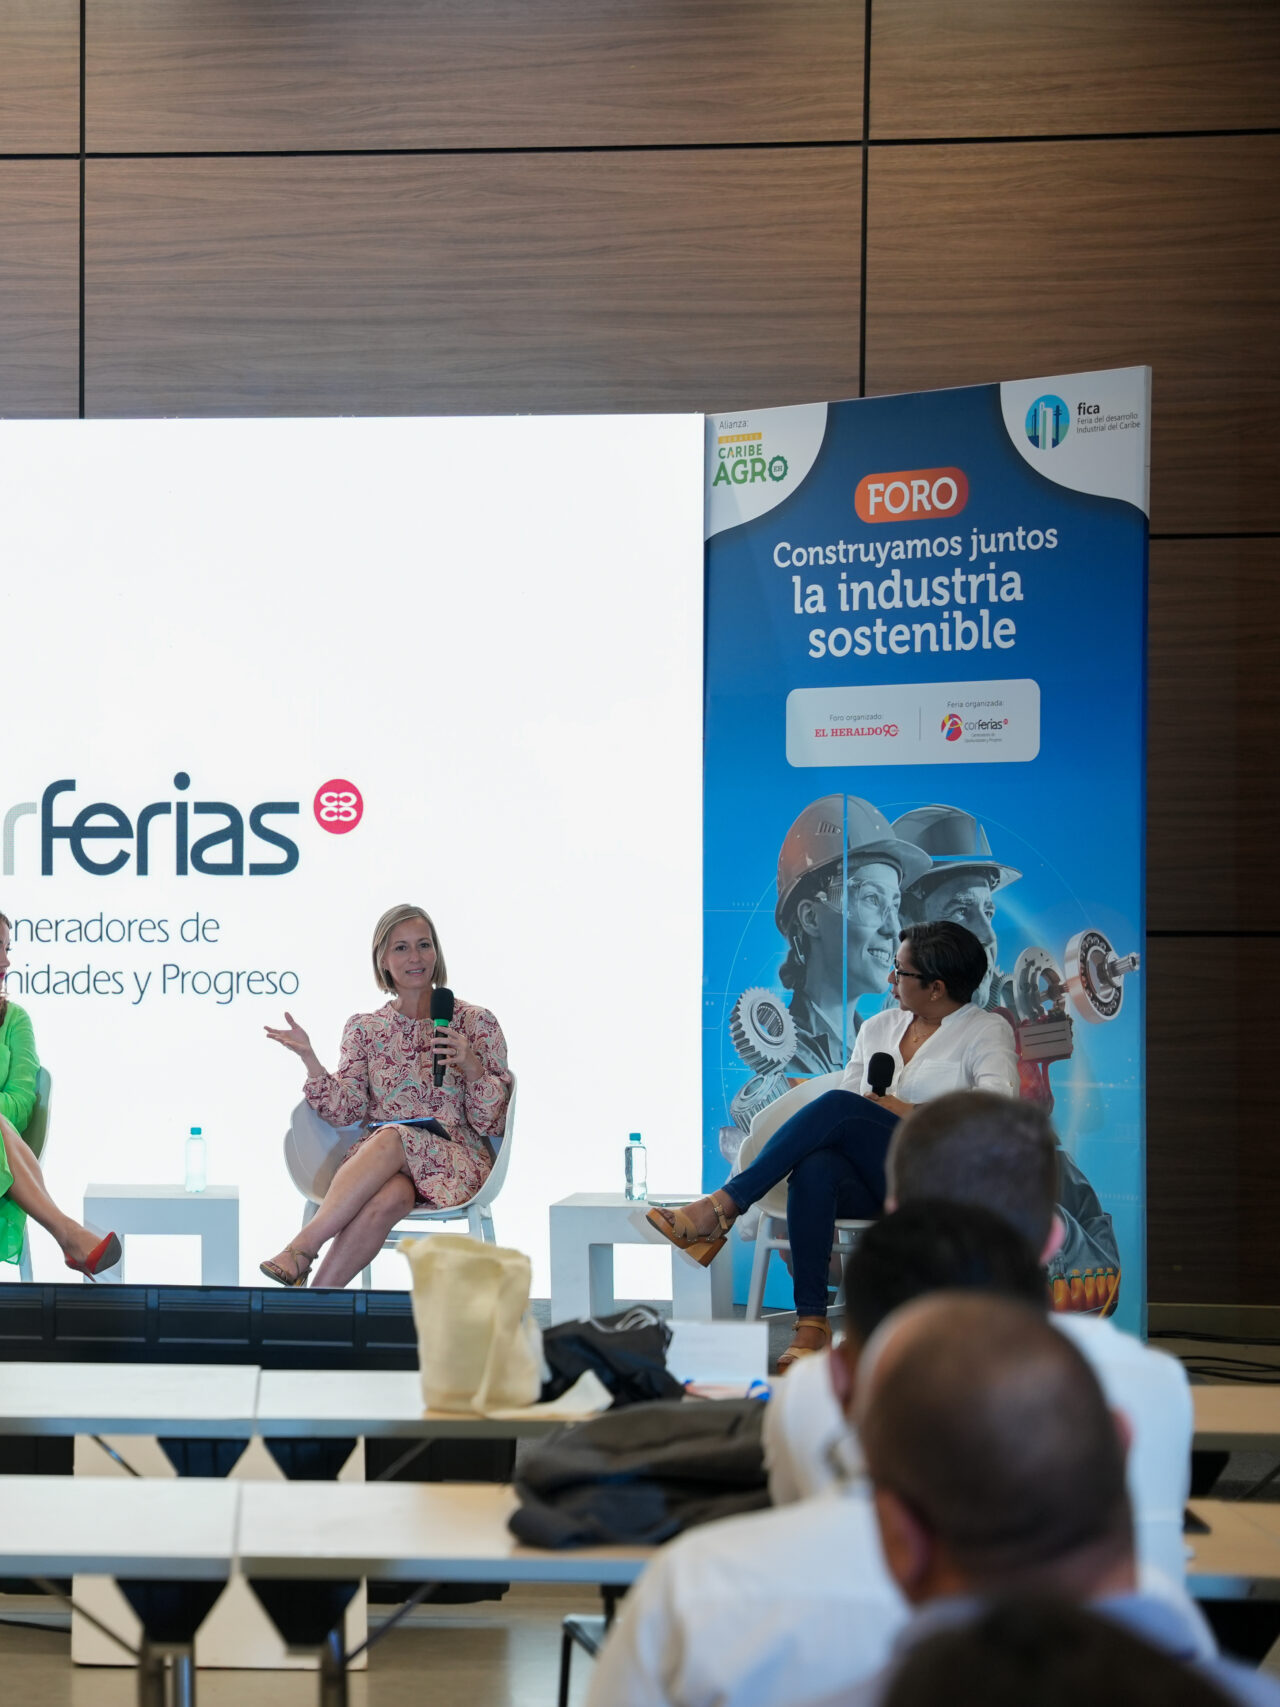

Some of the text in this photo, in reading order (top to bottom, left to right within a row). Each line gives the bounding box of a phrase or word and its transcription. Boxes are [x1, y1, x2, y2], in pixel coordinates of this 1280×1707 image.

[1077, 402, 1100, 416] fica
[718, 444, 762, 459] CARIBE
[712, 455, 788, 486] AGRO
[867, 476, 958, 516] FORO
[773, 526, 1059, 569] Construyamos juntos
[792, 562, 1024, 614] la industria
[808, 609, 1017, 658] sostenible
[814, 728, 828, 737] EL
[830, 727, 883, 737] HERALDO
[963, 718, 1003, 731] corferias
[8, 912, 220, 943] neradores de
[132, 970, 152, 1004] y
[162, 964, 300, 1003] Progreso
